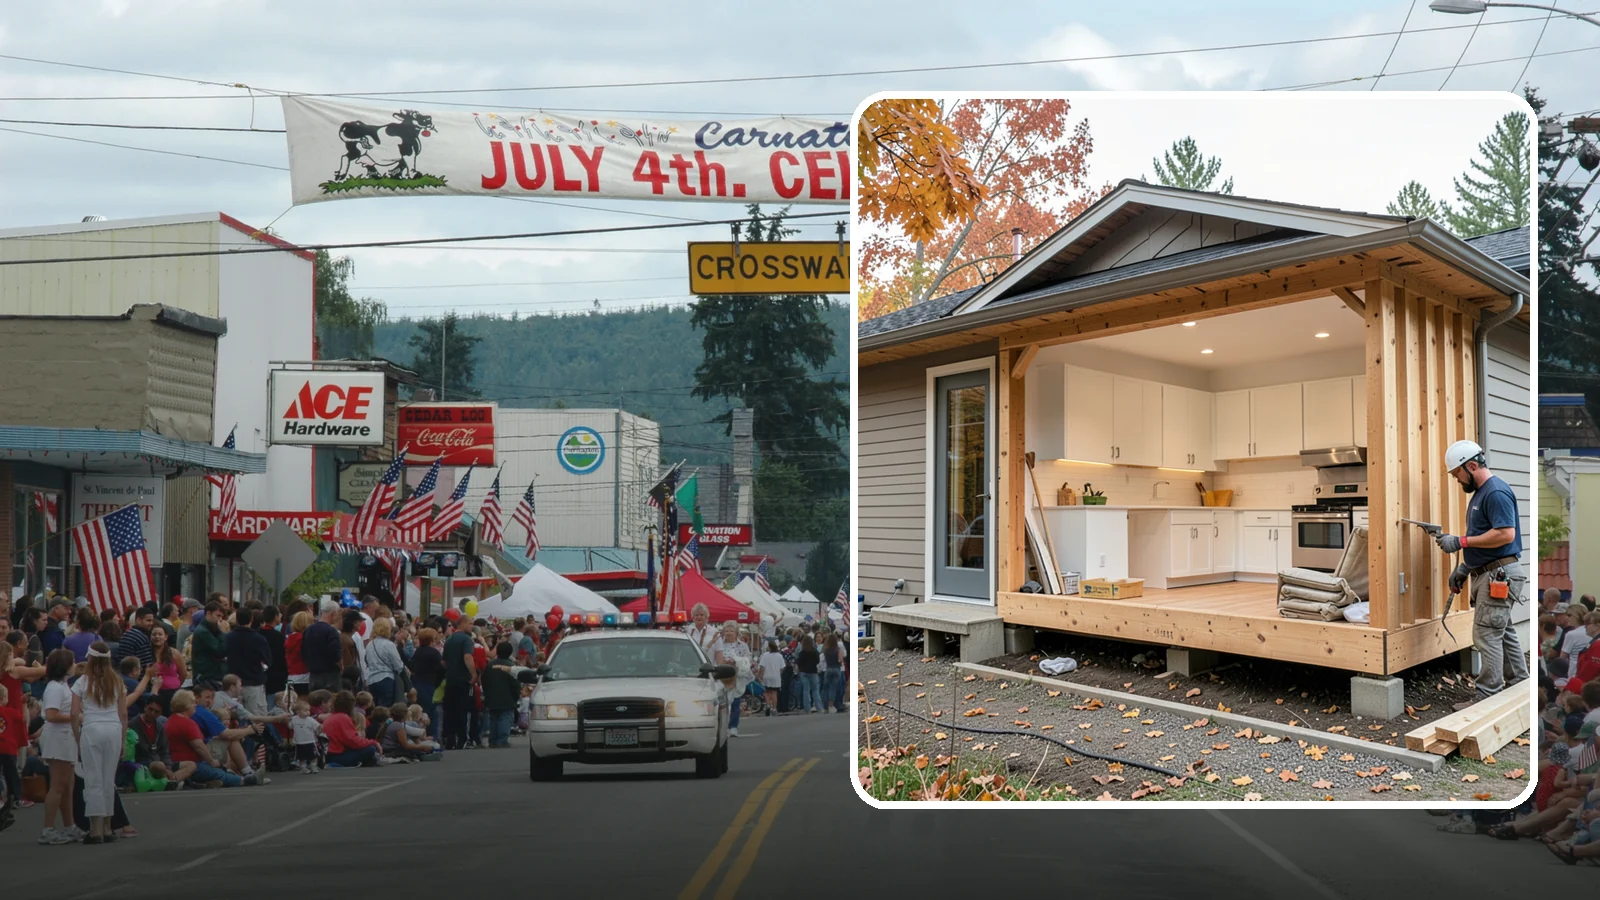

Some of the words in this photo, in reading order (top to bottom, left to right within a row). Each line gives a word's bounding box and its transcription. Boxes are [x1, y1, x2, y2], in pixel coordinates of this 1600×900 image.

[695, 121, 850, 149] Carnat
[481, 141, 605, 193] JULY
[632, 149, 746, 197] 4th.
[697, 254, 850, 280] CROSSWA
[283, 380, 373, 420] ACE
[406, 409, 452, 422] CEDAR
[283, 421, 370, 436] Hardware
[416, 428, 477, 447] Coca-Cola
[353, 467, 386, 480] Simpl
[95, 485, 124, 495] Vincent
[126, 486, 136, 495] de
[138, 486, 155, 495] Paul
[81, 503, 154, 522] THT
[688, 526, 742, 535] CRNATION
[699, 535, 730, 543] GLASS
